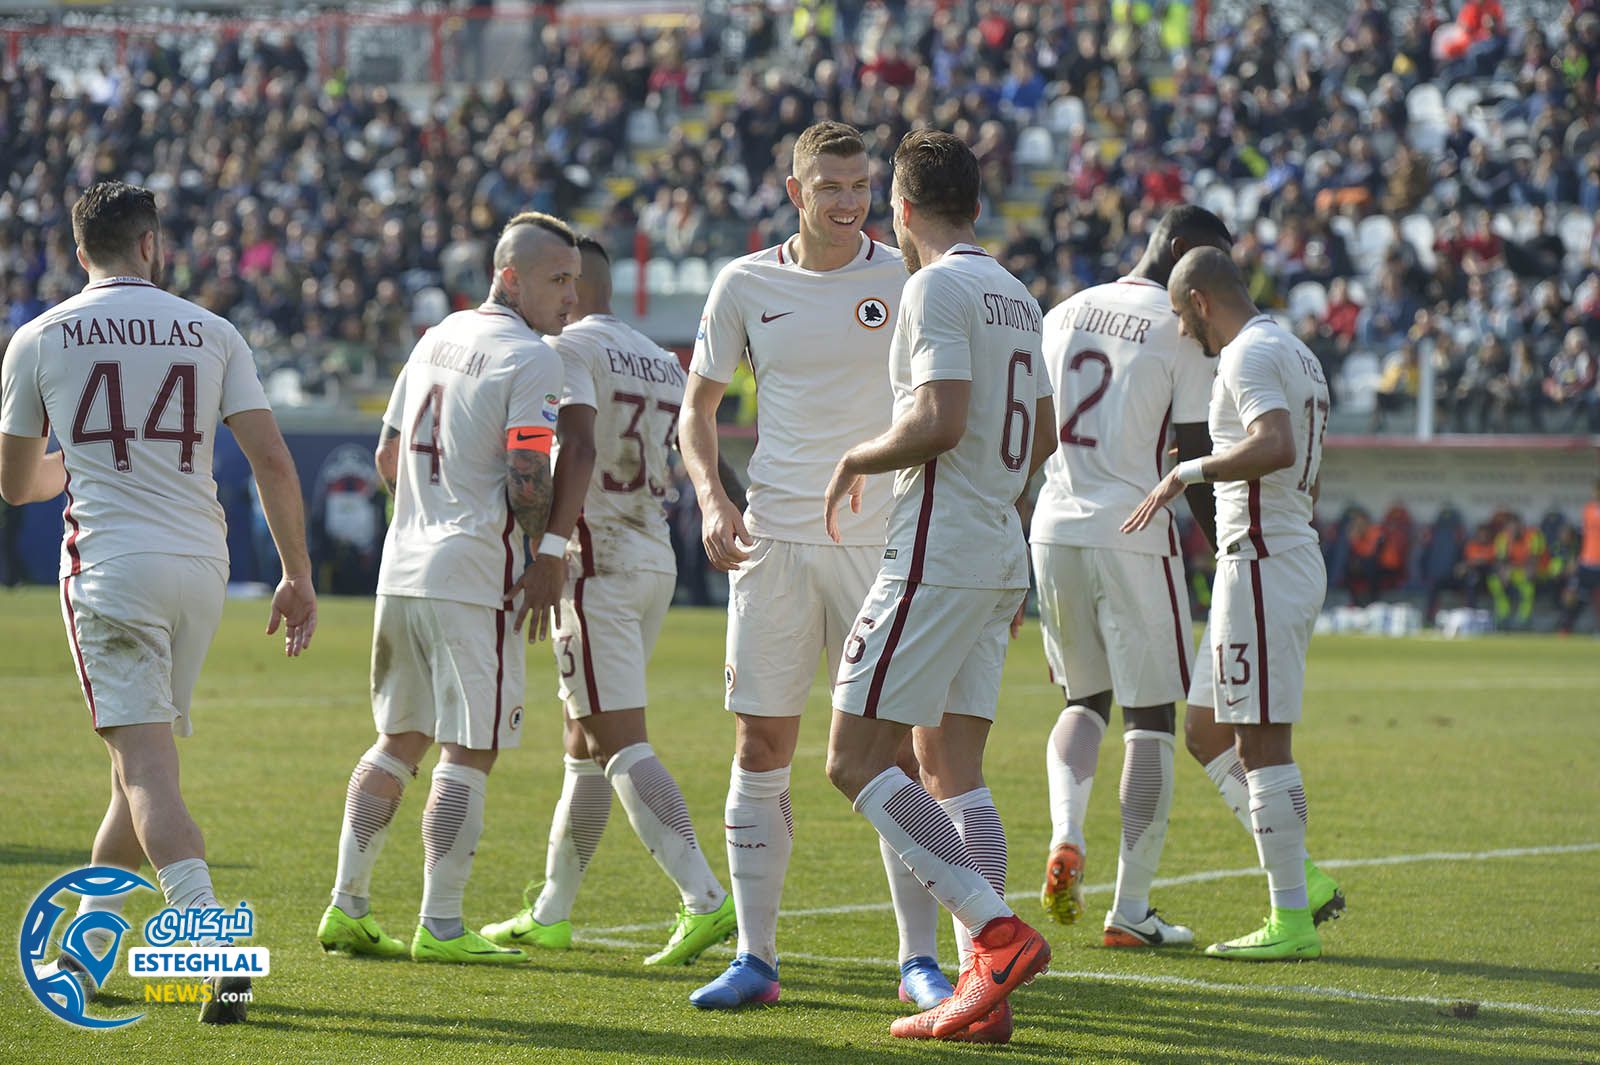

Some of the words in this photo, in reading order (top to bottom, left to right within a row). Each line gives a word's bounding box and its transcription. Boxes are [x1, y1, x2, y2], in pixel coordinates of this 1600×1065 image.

[61, 318, 204, 349] MANOLAS
[1060, 301, 1151, 345] RÜDIGER
[71, 360, 204, 473] 44
[410, 383, 444, 486] 4
[1000, 349, 1033, 472] 6
[1060, 349, 1113, 448] 2
[1216, 643, 1250, 686] 13
